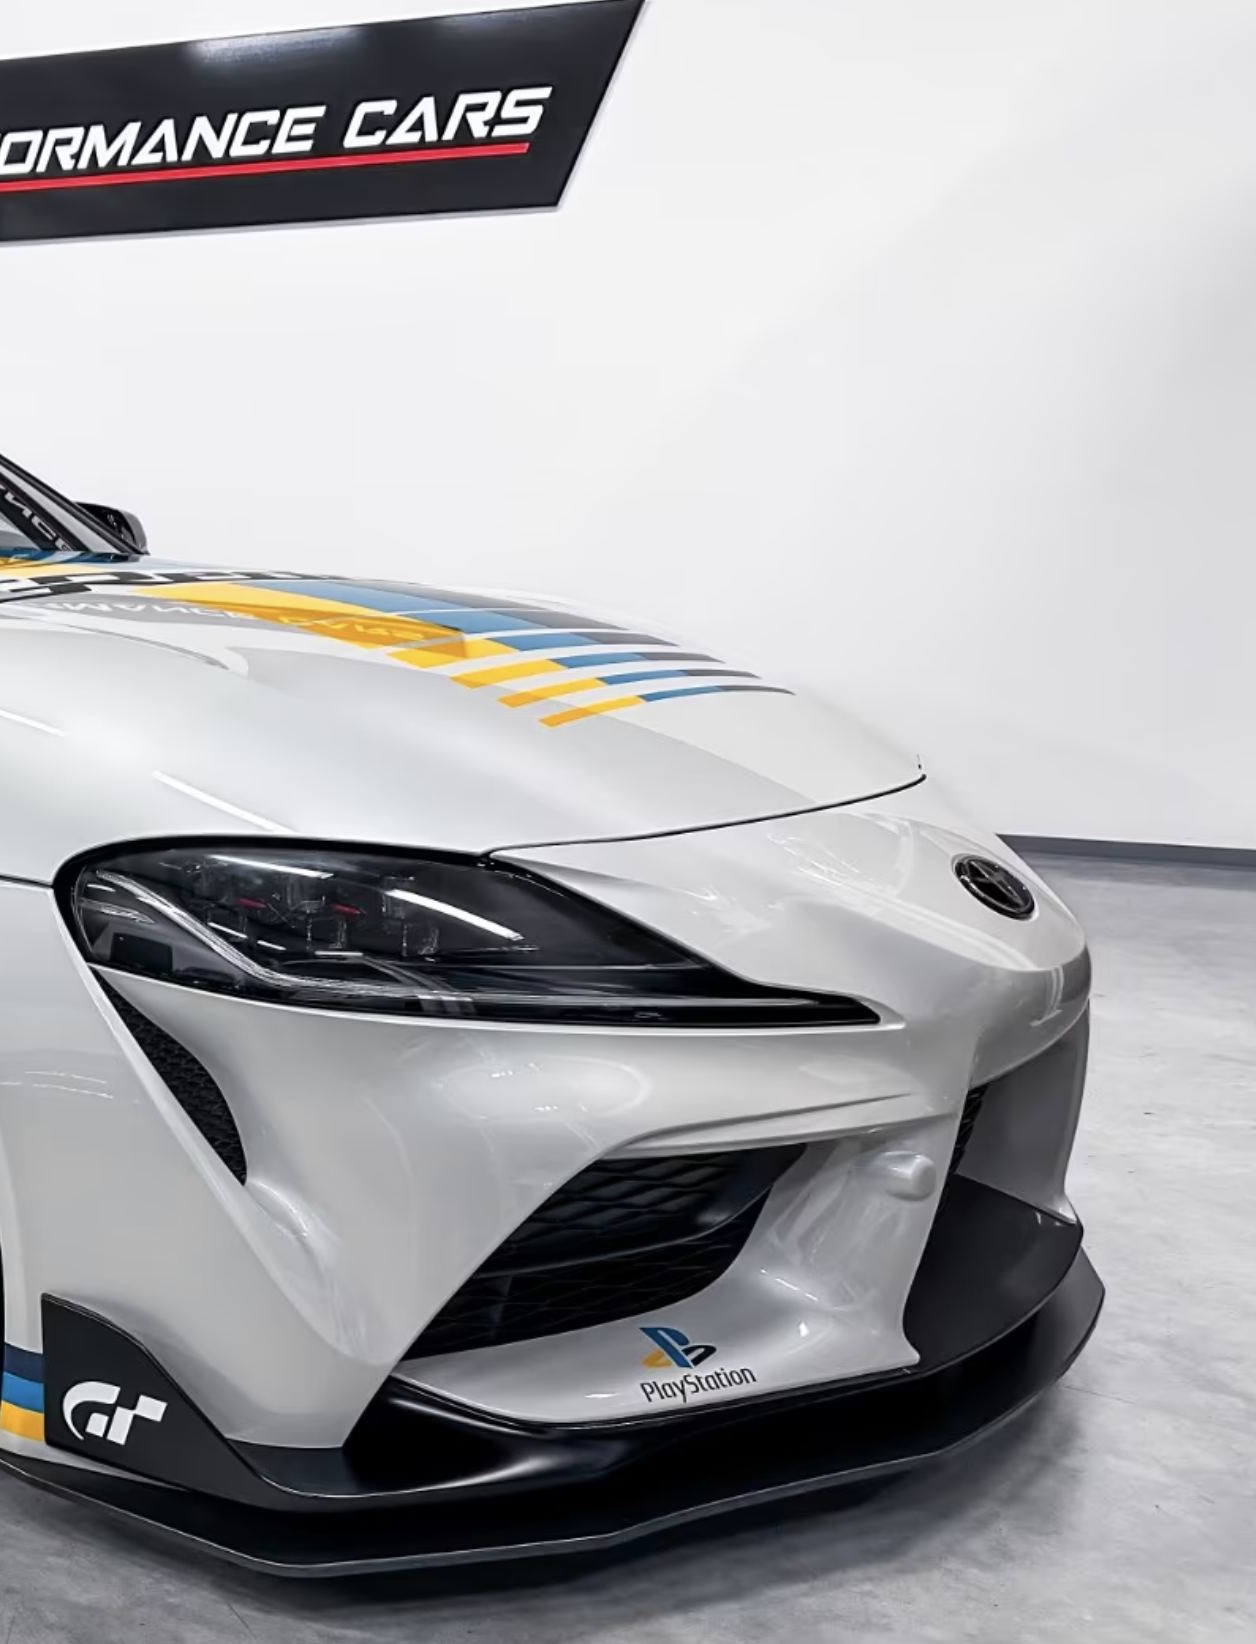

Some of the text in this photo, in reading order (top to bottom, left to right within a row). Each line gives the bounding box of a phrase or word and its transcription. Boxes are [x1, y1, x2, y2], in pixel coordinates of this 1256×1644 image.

[344, 87, 552, 148] CARS
[62, 1380, 168, 1446] GT
[639, 1366, 757, 1404] PlayStation
